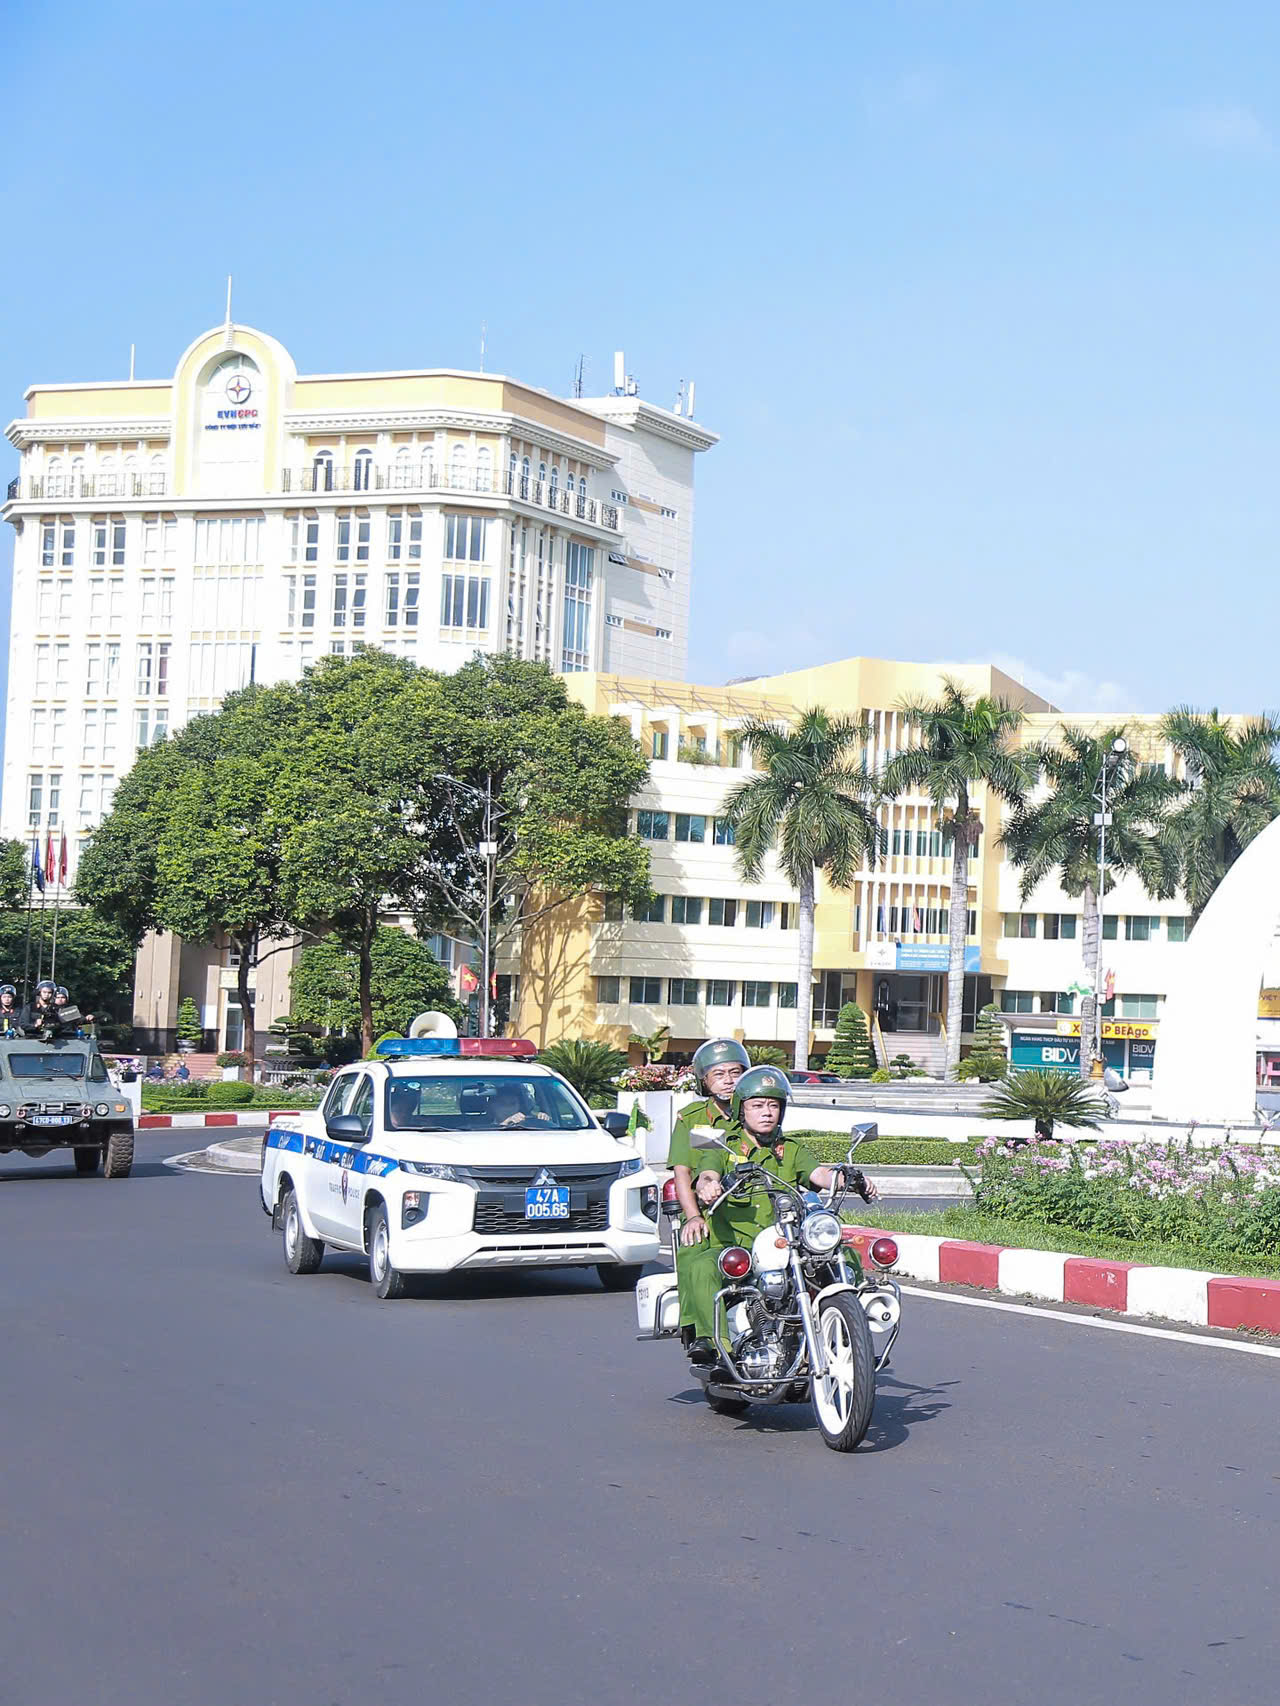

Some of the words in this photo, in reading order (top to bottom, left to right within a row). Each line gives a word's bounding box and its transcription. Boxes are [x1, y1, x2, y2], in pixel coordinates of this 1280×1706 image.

[217, 409, 258, 419] EVNCPC
[1115, 1026, 1149, 1038] BEAgo
[1042, 1046, 1079, 1062] BIDV
[1132, 1044, 1154, 1053] BIDV
[341, 1152, 354, 1169] GIAO
[536, 1189, 559, 1202] 47A
[527, 1203, 568, 1217] 005.65
